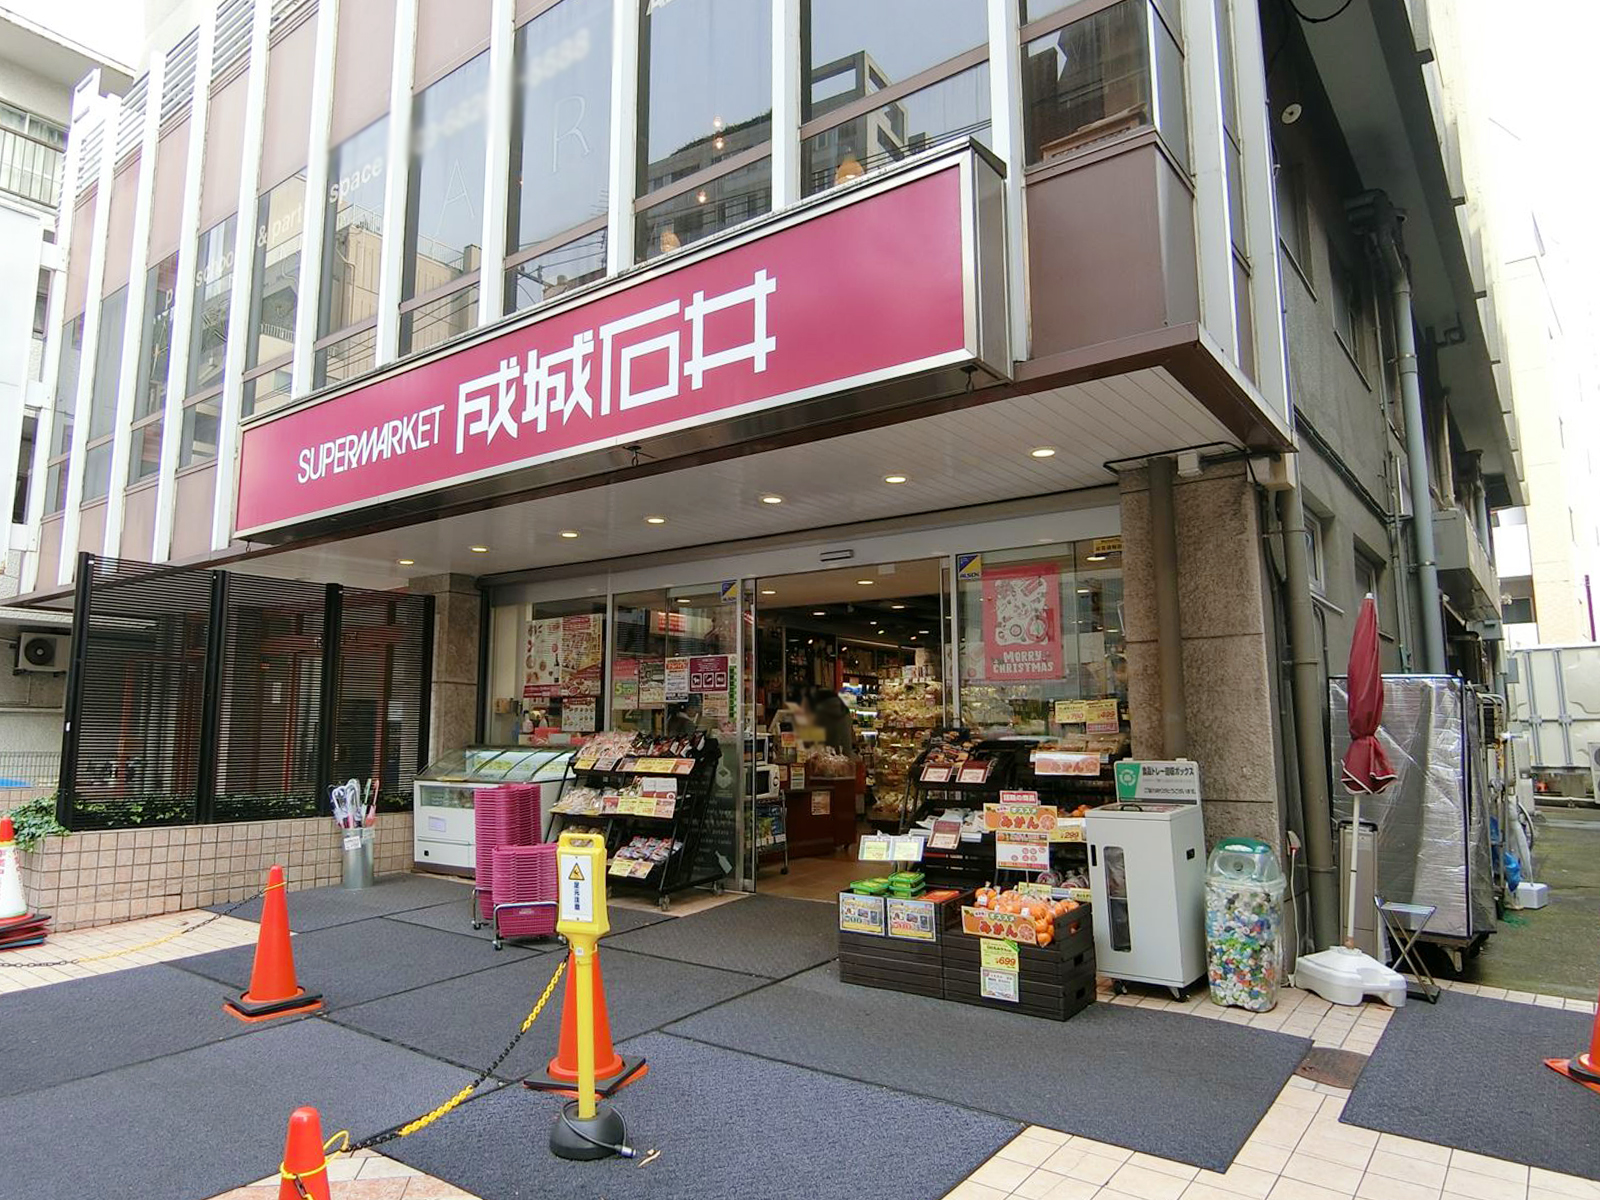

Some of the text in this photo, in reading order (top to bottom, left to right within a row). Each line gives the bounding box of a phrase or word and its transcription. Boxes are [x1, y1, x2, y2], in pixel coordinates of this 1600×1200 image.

[329, 156, 384, 203] space
[456, 268, 777, 454] 成城石井
[298, 404, 445, 484] SUPERMARKET
[1000, 816, 1040, 829] みかん
[573, 882, 581, 910] 足元注意
[980, 920, 1019, 938] みかん
